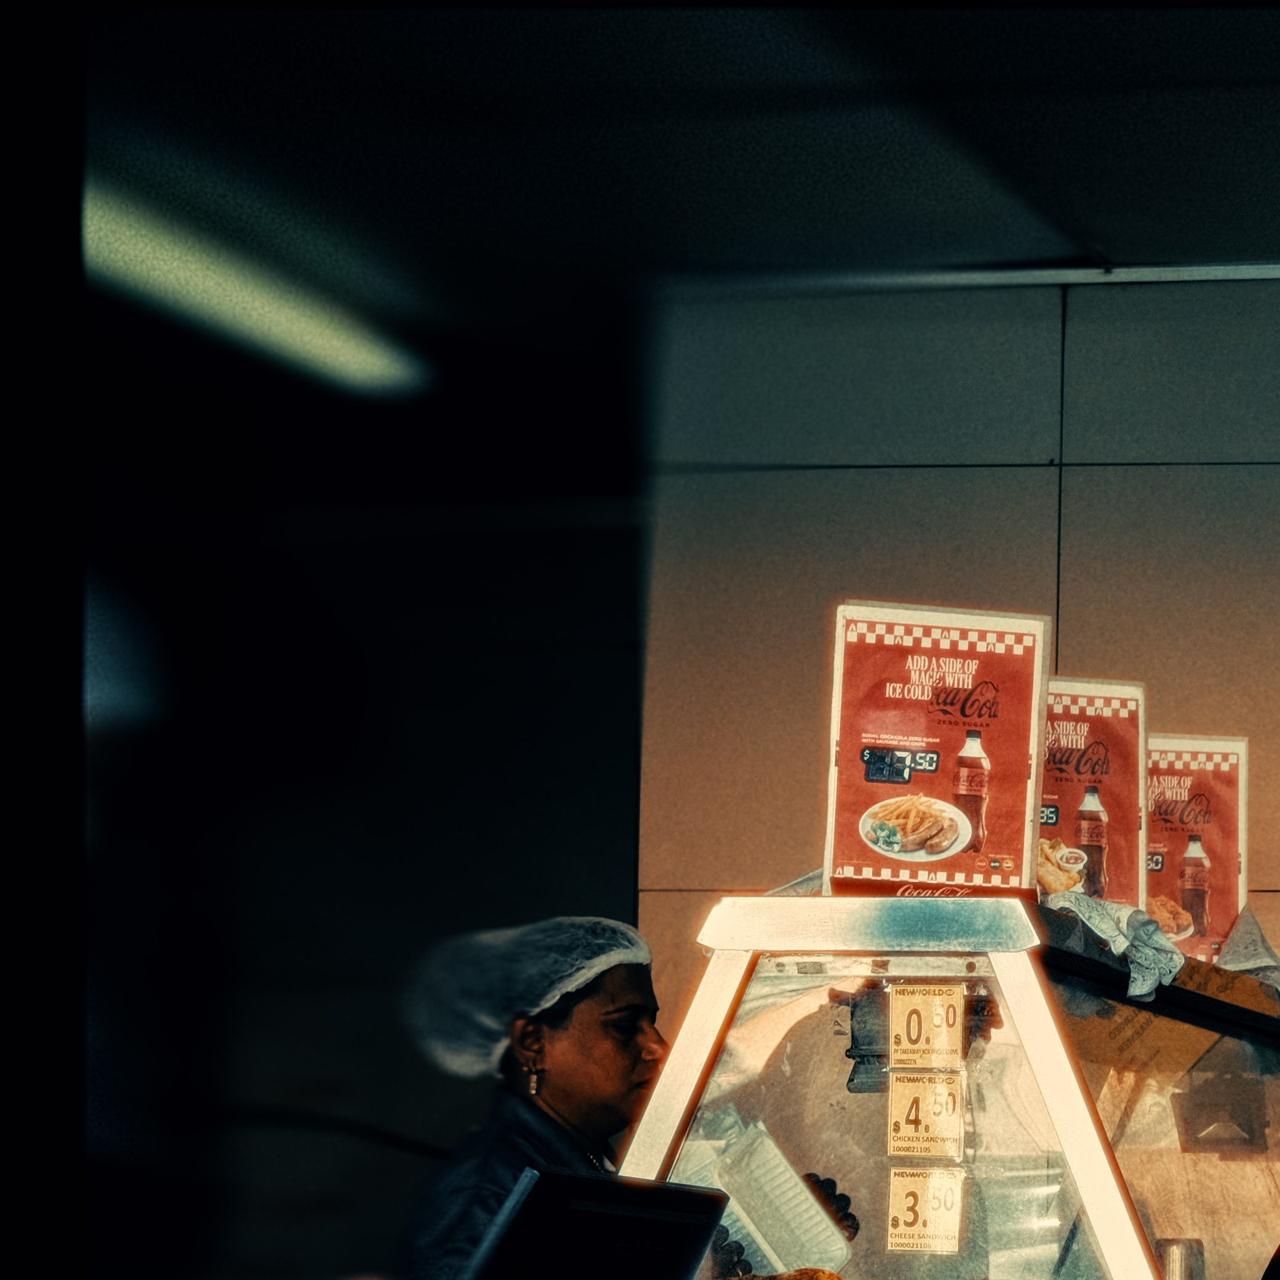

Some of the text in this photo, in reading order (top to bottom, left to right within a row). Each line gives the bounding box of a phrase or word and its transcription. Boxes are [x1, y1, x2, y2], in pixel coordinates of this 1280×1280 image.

[906, 655, 979, 675] ADD A SIDE OF
[910, 670, 972, 688] MAGIC WITH
[885, 682, 932, 700] ICE COLD
[1054, 721, 1075, 735] SIDE
[1077, 722, 1089, 736] OF
[1060, 735, 1085, 749] WITH
[1160, 776, 1180, 788] SIDE
[1180, 776, 1193, 789] OF
[1165, 788, 1188, 800] WITH
[921, 1136, 958, 1144] SANDWICH
[890, 1232, 914, 1240] CHEESE
